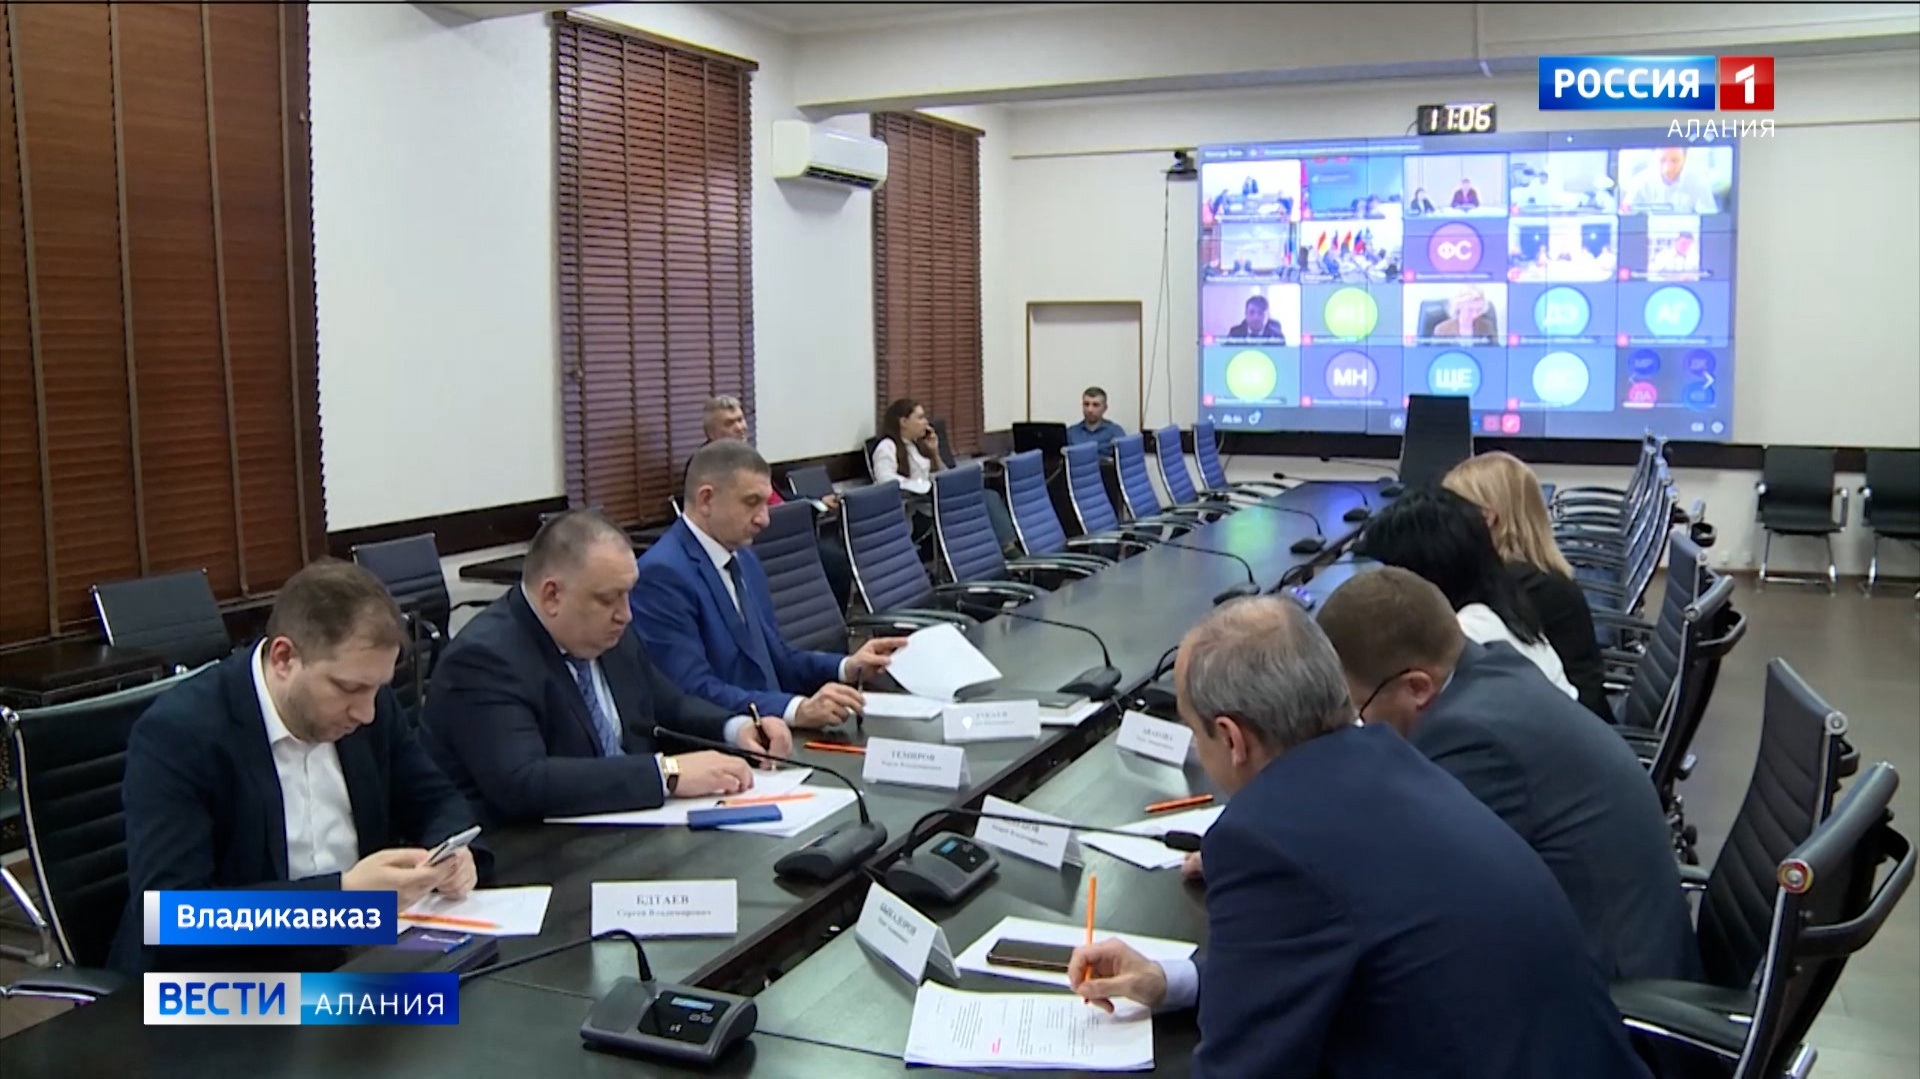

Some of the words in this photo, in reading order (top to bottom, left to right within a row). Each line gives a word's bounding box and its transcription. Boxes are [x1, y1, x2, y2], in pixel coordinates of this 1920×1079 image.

[1430, 105, 1491, 132] 11:06
[1436, 240, 1473, 261] ФС
[1333, 368, 1368, 387] МН
[1435, 368, 1473, 392] ЩЕ
[891, 750, 936, 761] ТЕМИРОВ
[636, 894, 690, 906] БДТАЕВ
